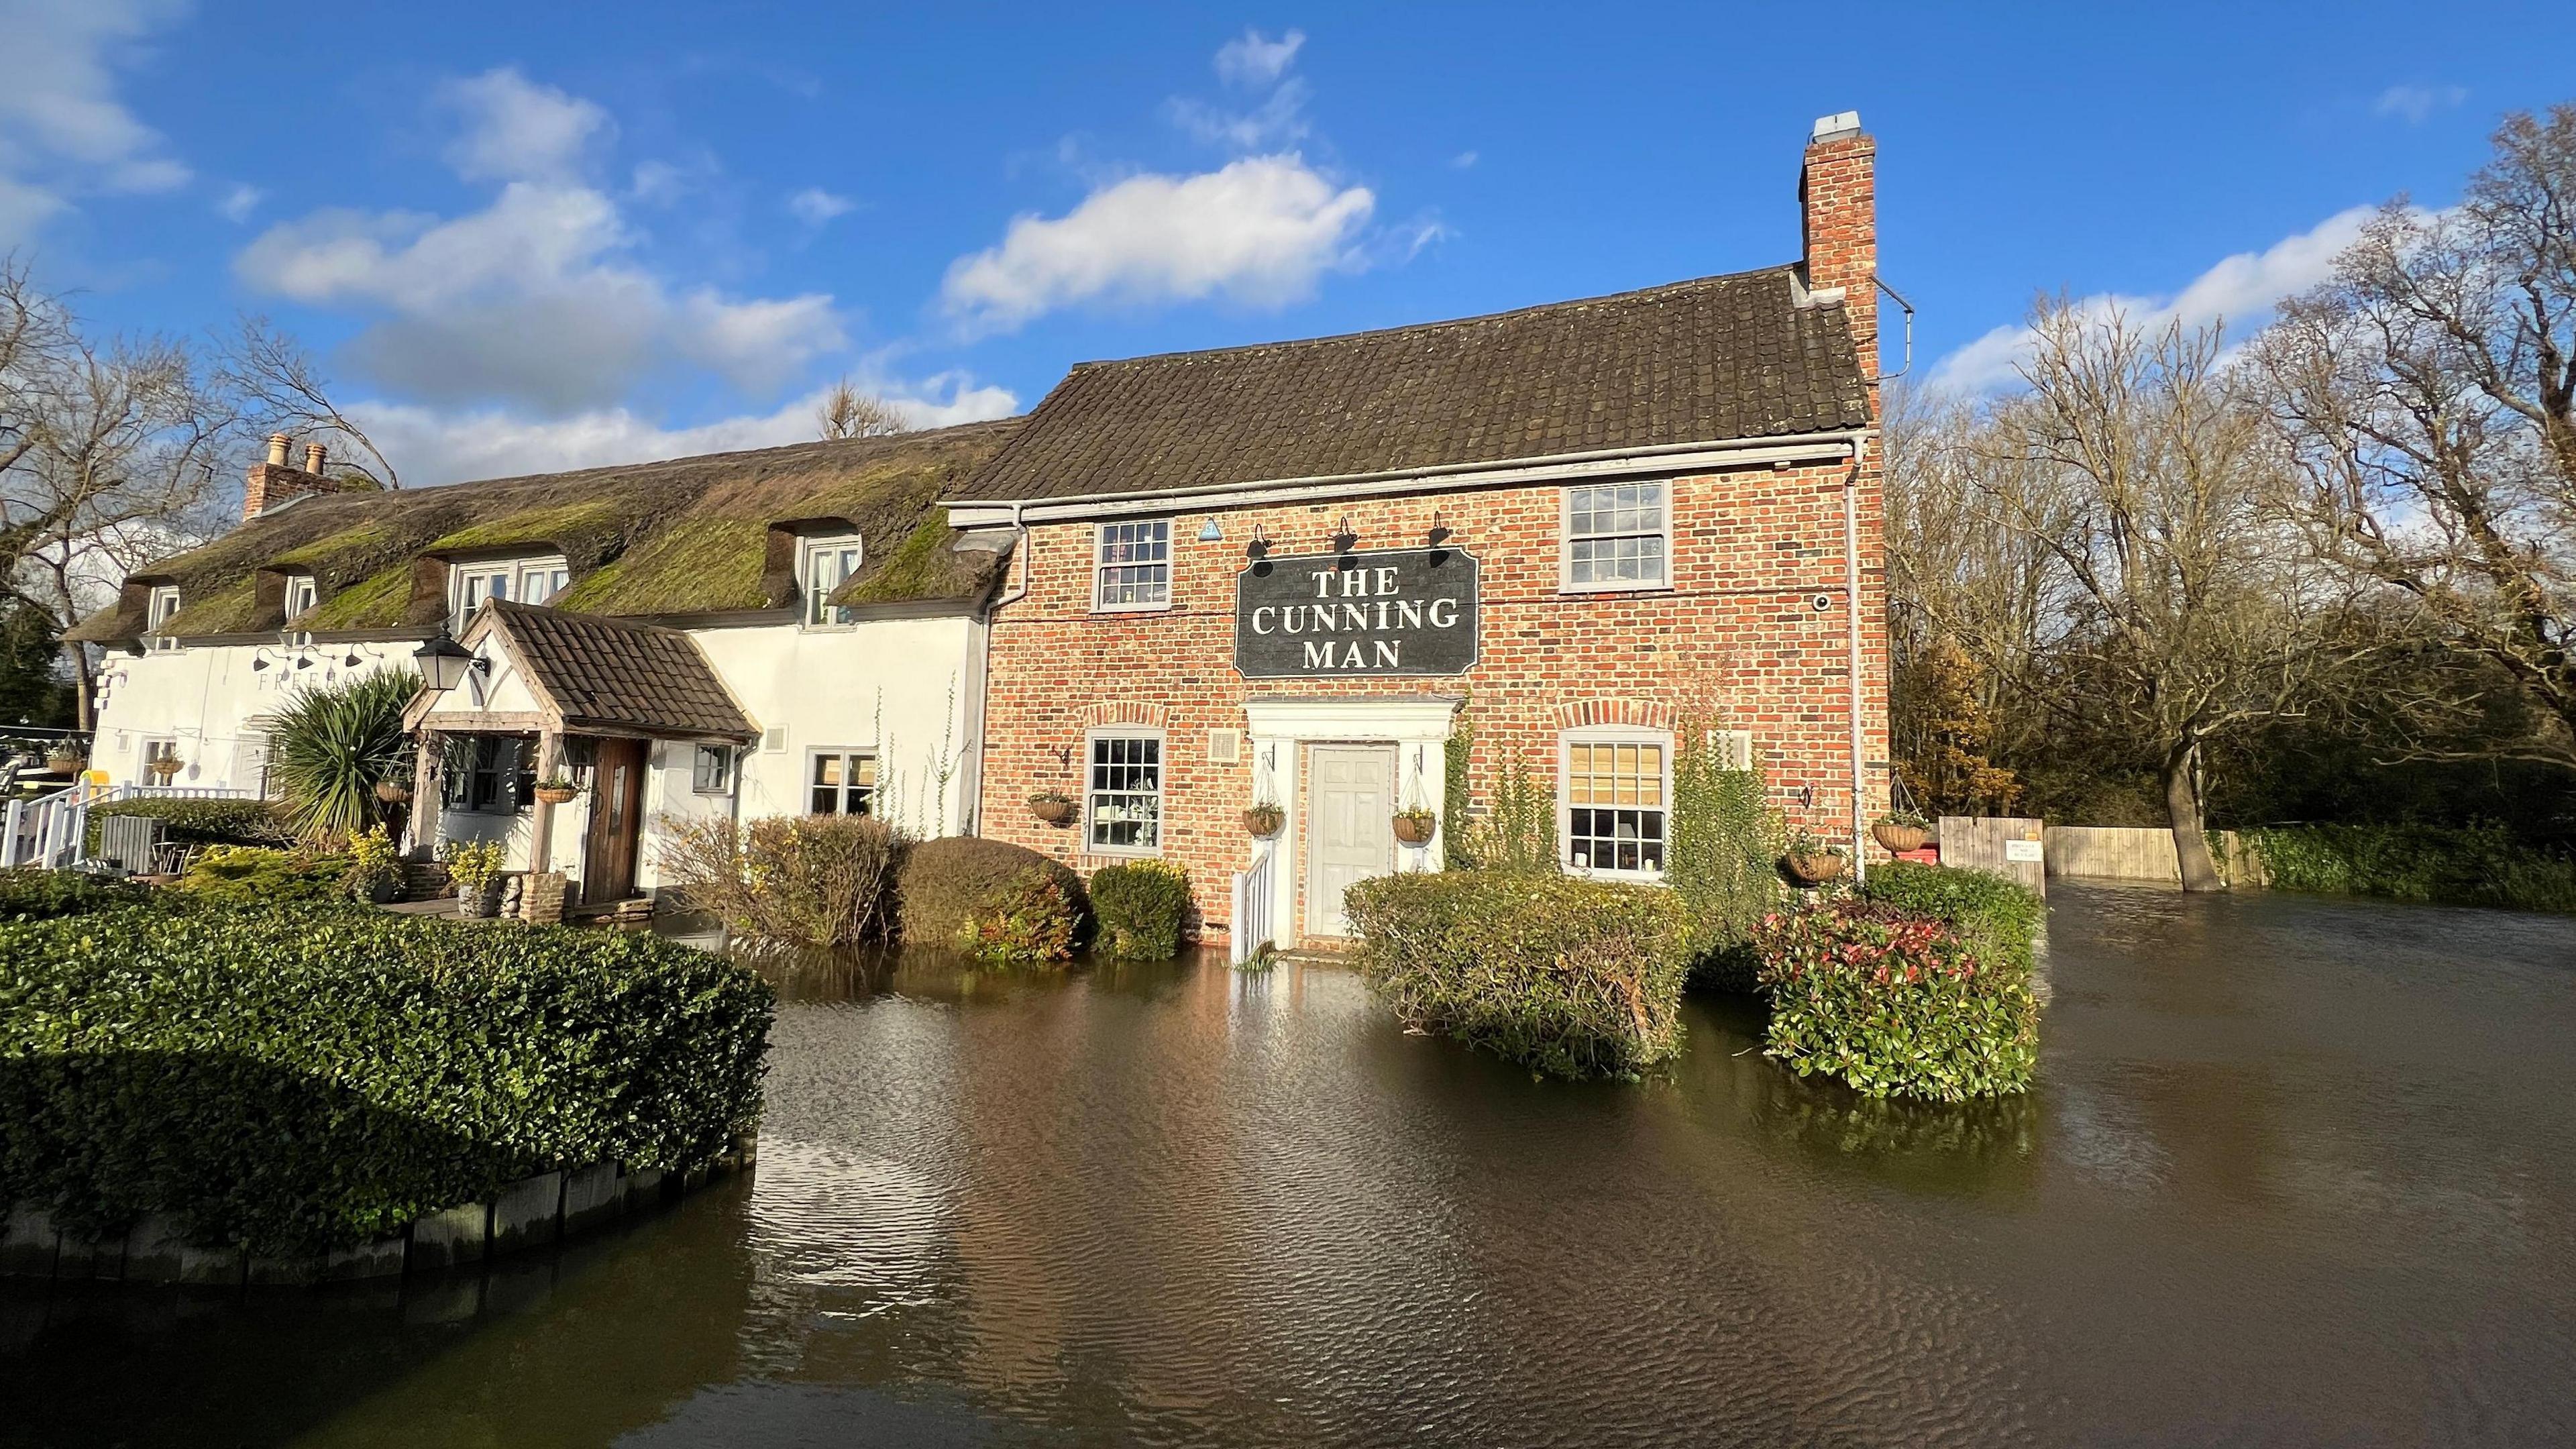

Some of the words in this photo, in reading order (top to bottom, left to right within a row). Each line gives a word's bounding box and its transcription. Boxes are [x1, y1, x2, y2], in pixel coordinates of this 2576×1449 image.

[1311, 566, 1400, 598] THE
[1252, 597, 1460, 635] CUNNING
[1302, 640, 1402, 669] MAN
